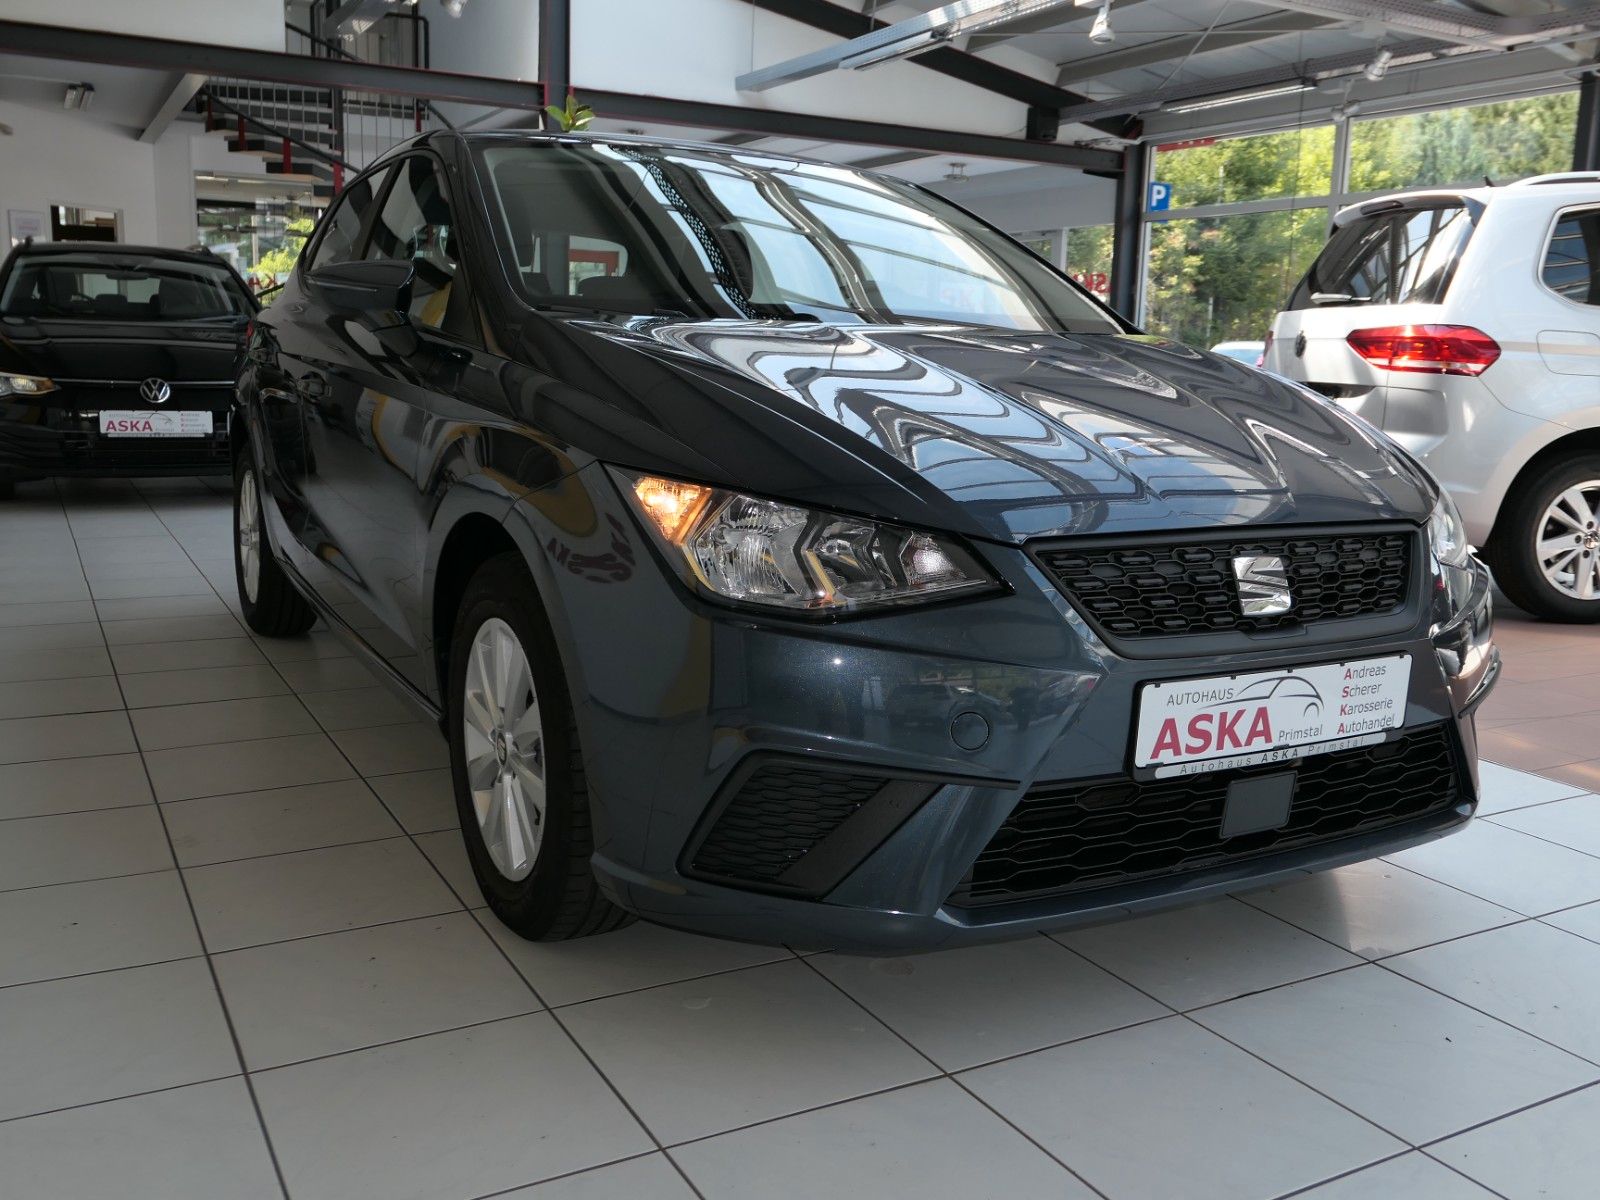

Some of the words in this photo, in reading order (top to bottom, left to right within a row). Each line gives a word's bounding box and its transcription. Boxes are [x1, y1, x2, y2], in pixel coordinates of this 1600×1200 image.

[1151, 184, 1167, 207] P
[106, 420, 153, 432] ASKA
[1344, 665, 1387, 680] Andreas
[1166, 688, 1235, 706] AUTOHAUS
[1342, 683, 1382, 698] Scherer
[1339, 698, 1393, 716] Karosserie
[1150, 706, 1273, 760] ASKA
[1279, 724, 1323, 741] Primstal
[1337, 714, 1395, 735] Autohandel
[1180, 757, 1251, 775] Autohaus
[1261, 748, 1299, 763] ASKA
[1308, 736, 1365, 755] Primstal
